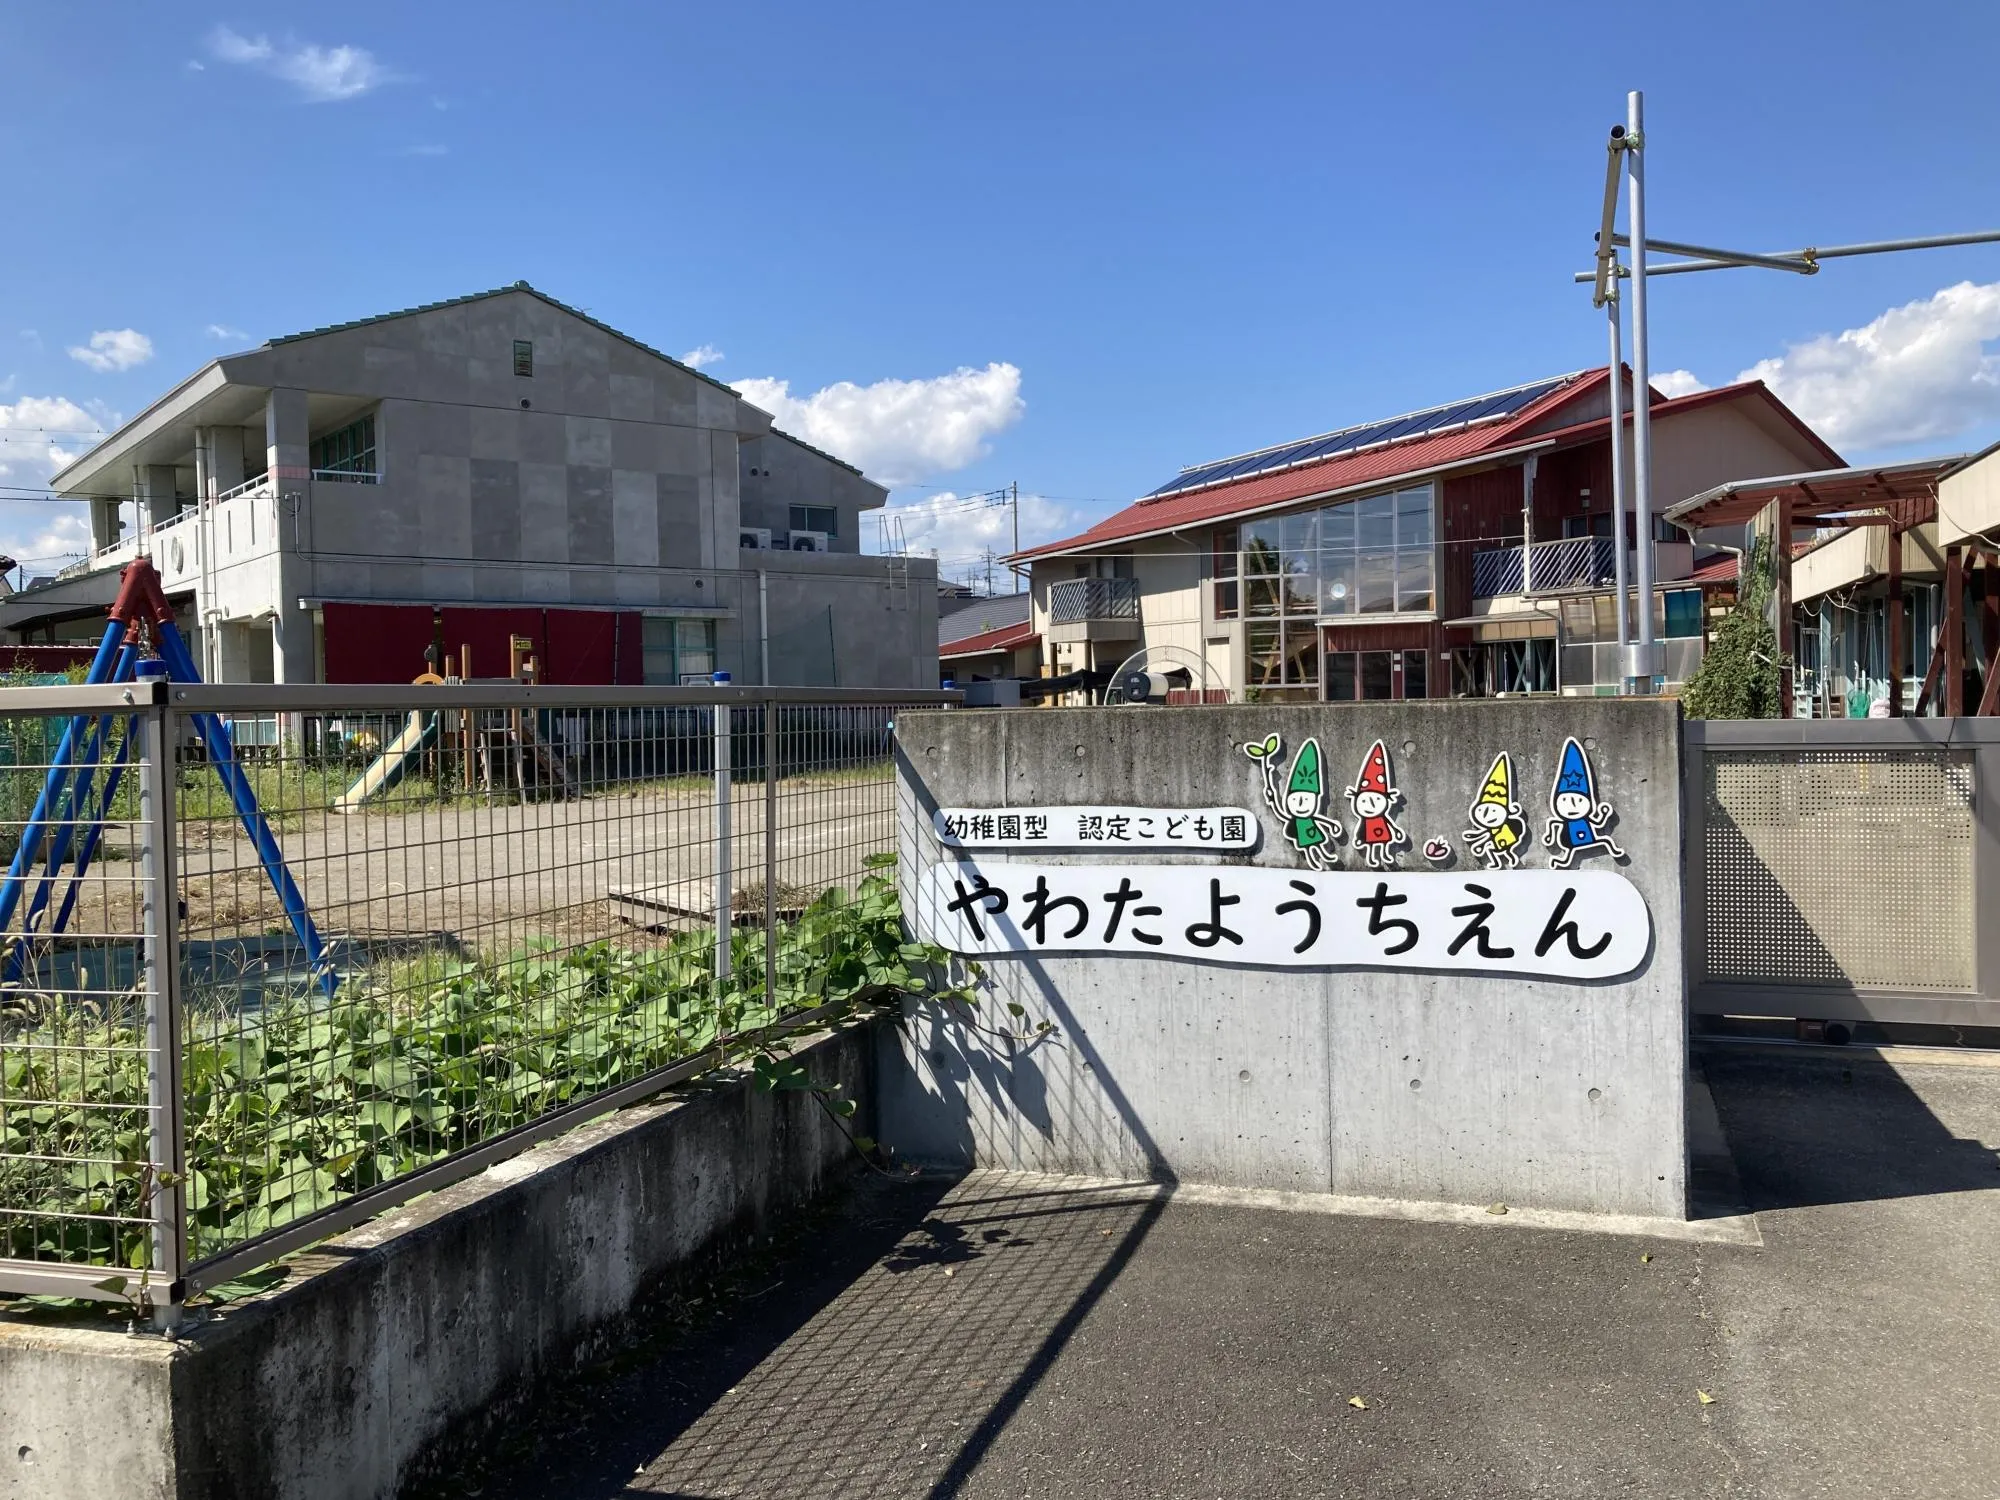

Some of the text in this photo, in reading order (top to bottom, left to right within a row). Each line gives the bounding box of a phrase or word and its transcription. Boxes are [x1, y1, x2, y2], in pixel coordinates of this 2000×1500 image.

[944, 815, 1246, 842] 幼稚園型 認定こども園
[946, 874, 1613, 960] やわたようちえん
